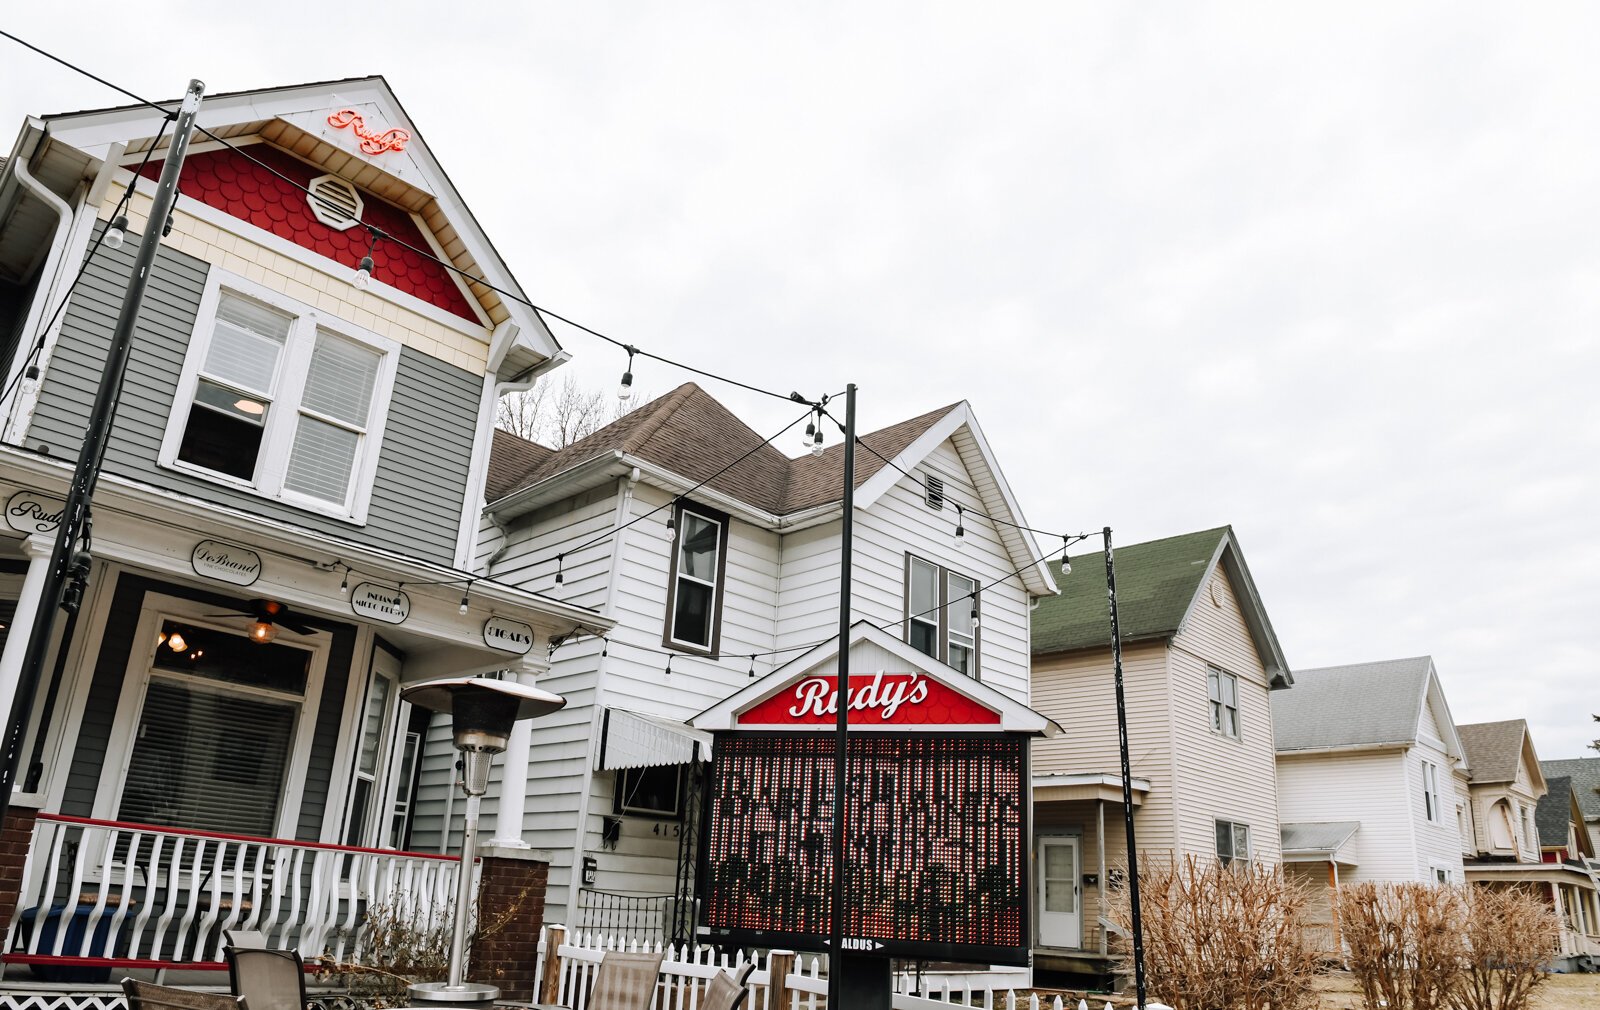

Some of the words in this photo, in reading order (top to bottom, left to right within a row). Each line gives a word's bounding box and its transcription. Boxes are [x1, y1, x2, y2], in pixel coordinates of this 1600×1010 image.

[197, 548, 259, 573] DeBrand
[356, 599, 378, 610] MICRO
[367, 592, 394, 604] INDIAN
[487, 626, 530, 645] CIGARS
[789, 669, 929, 719] Rudy's
[653, 822, 680, 838] 415
[841, 937, 873, 951] ALDUS
